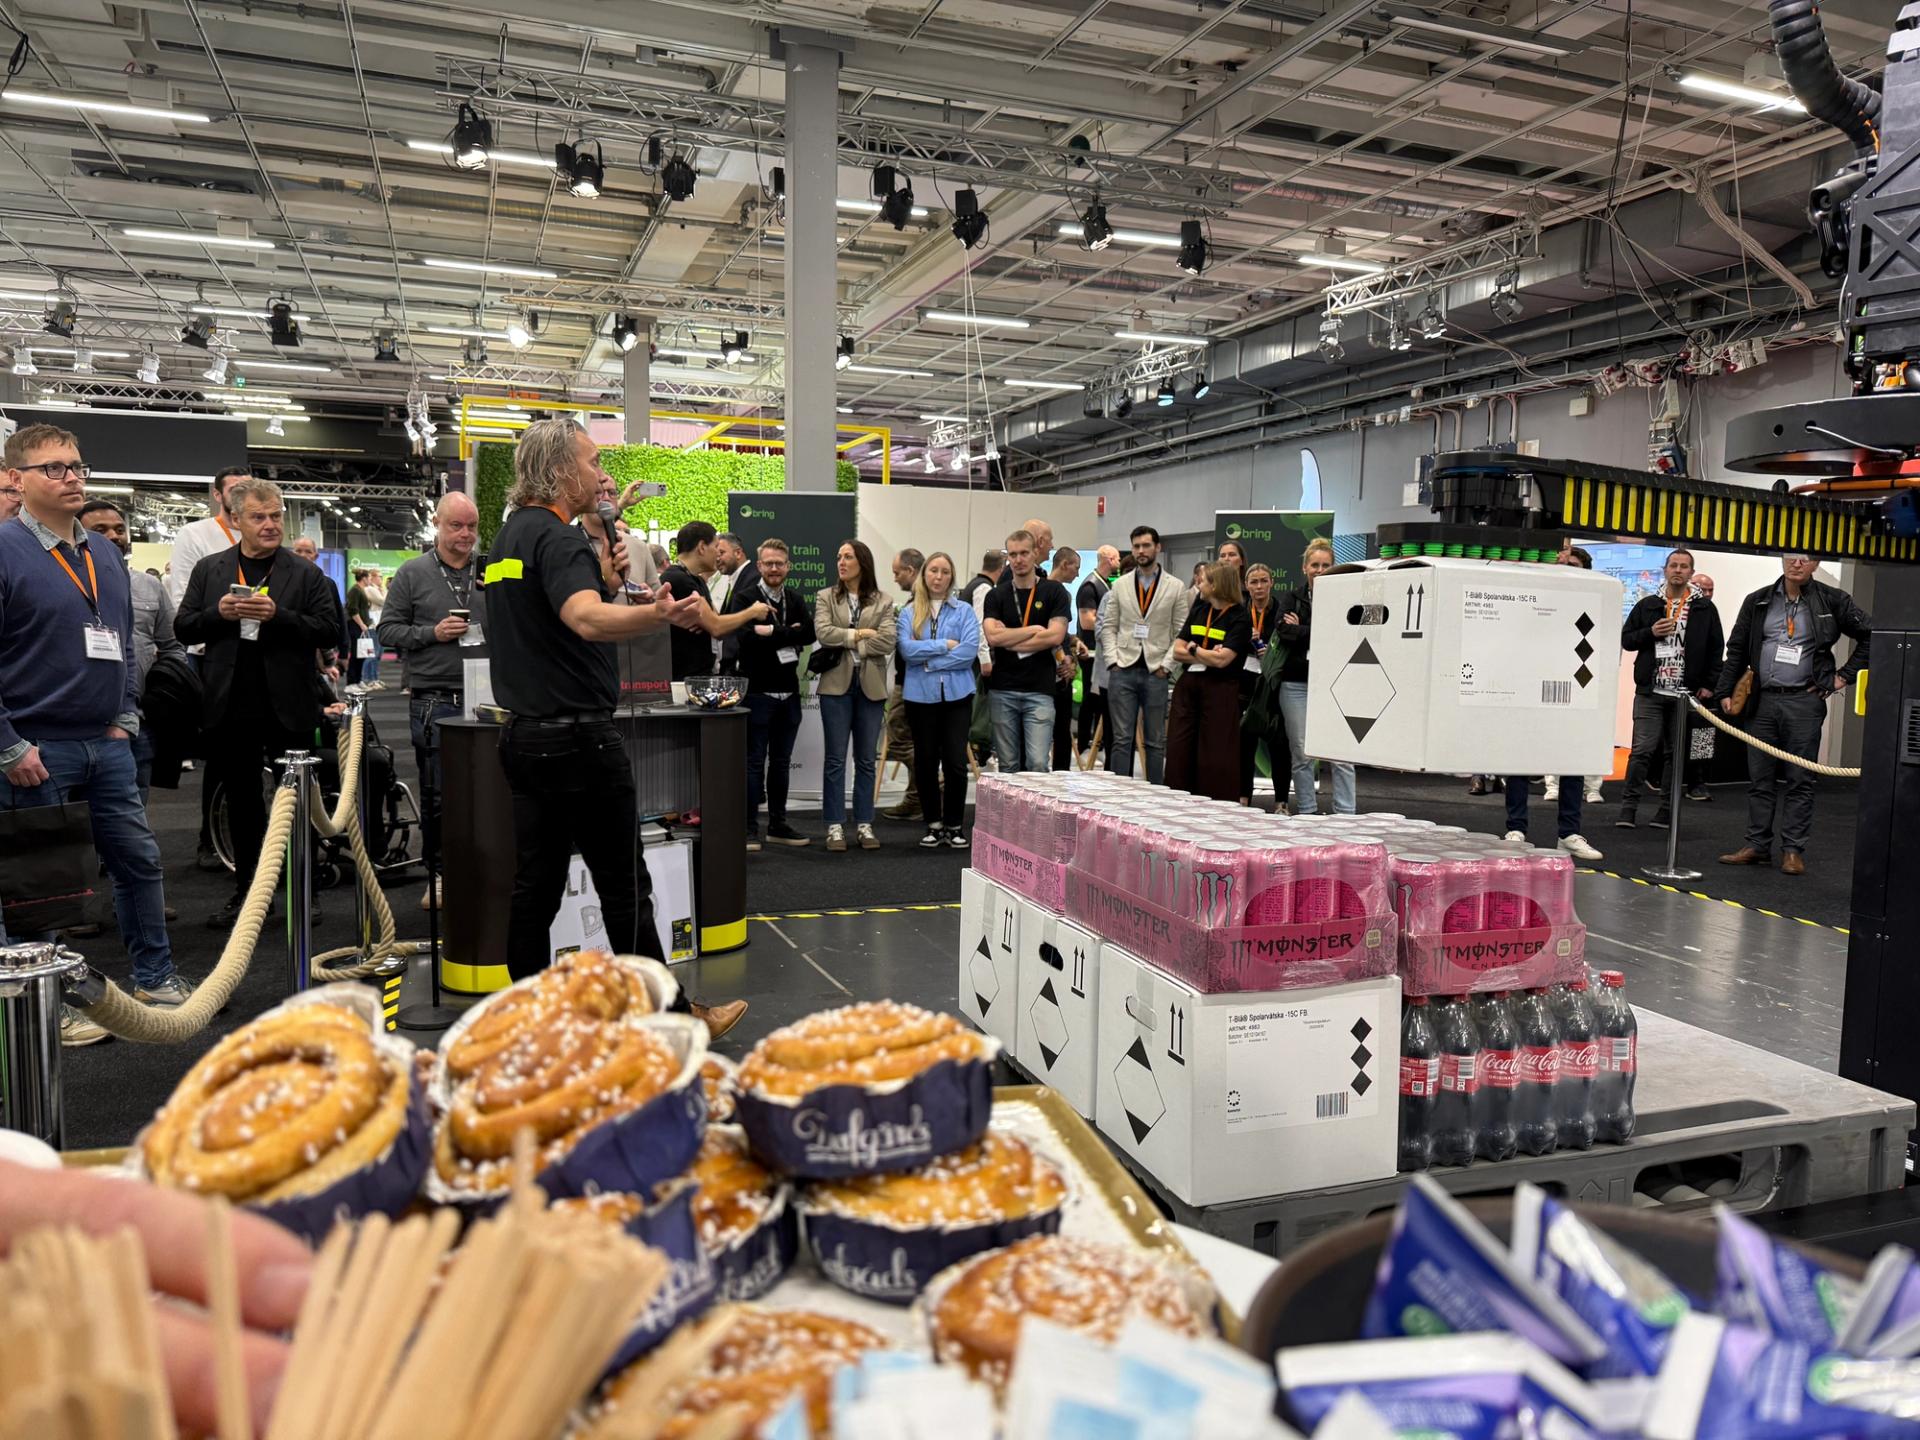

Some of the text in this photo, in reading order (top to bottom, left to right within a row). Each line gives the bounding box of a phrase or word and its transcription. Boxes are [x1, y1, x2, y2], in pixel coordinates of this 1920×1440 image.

[752, 508, 775, 520] bring
[1242, 528, 1272, 541] bring
[793, 544, 820, 556] train
[788, 560, 825, 573] ecting
[804, 577, 826, 588] and
